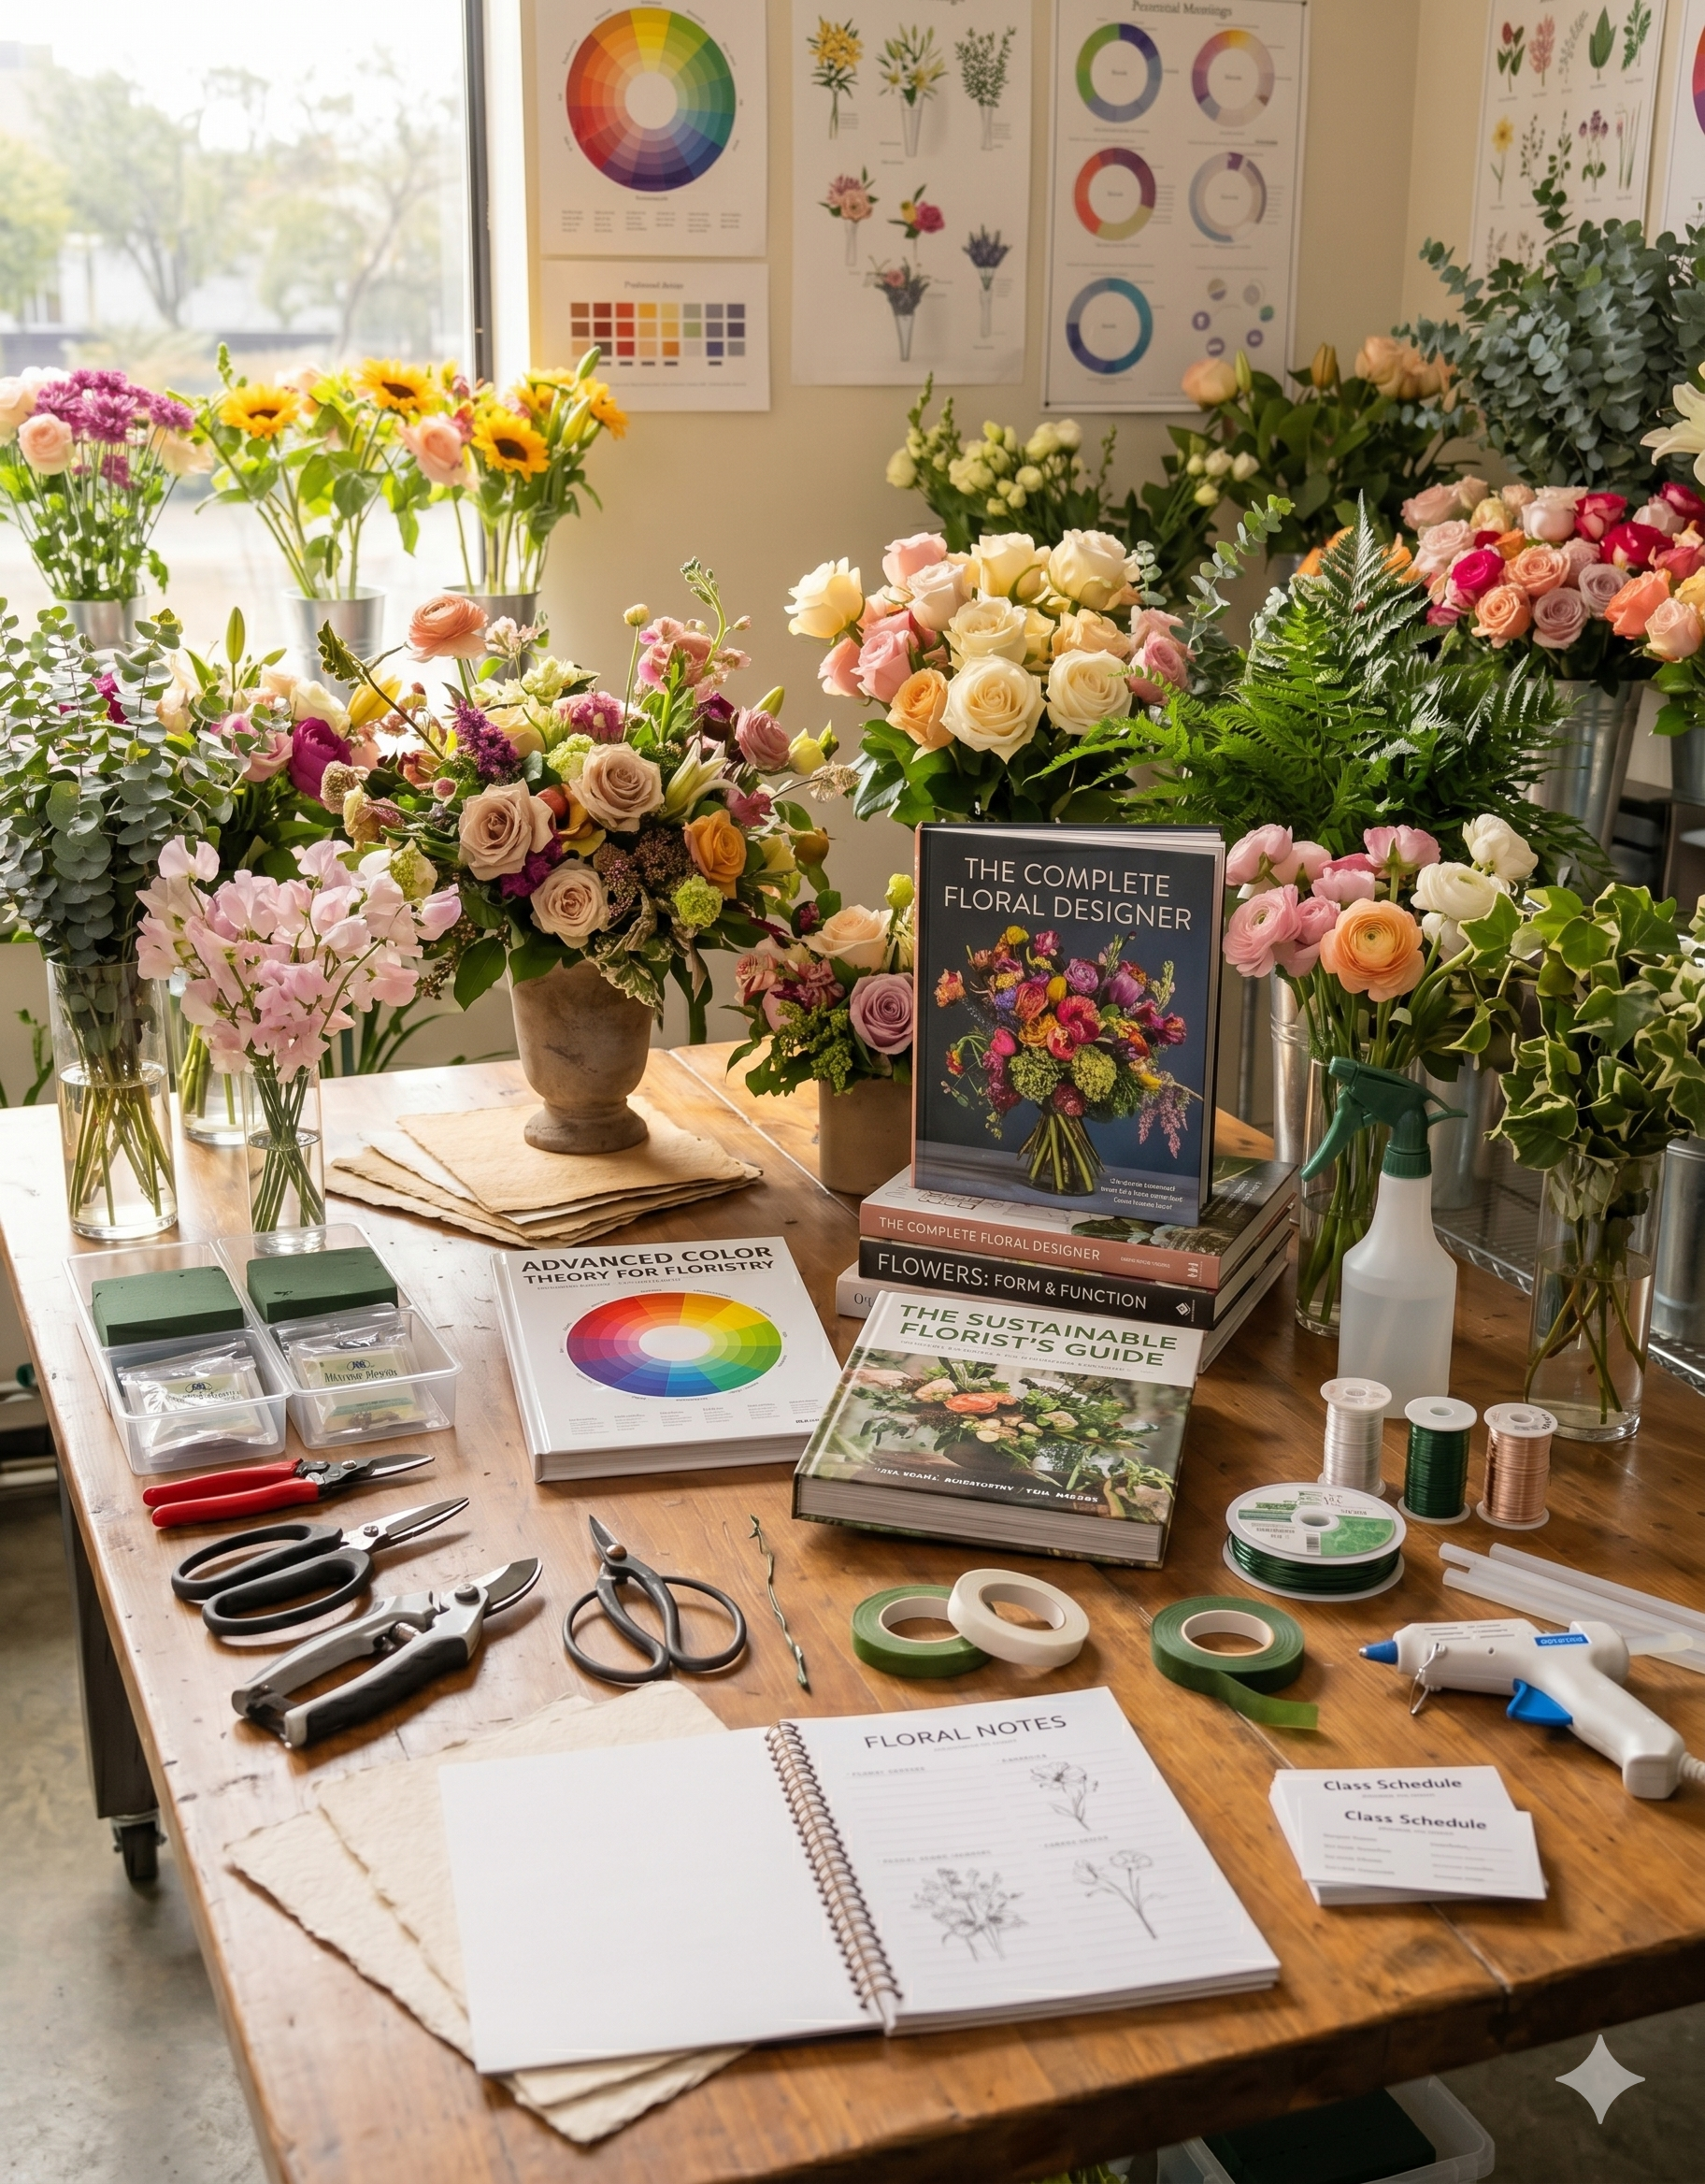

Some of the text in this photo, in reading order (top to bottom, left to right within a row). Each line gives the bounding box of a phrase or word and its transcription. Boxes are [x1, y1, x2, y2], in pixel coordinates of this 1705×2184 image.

[964, 857, 1170, 898] THE COMPLETE
[944, 886, 1192, 930] FLORAL DESIGNER
[522, 1246, 774, 1272] ADVANCED COLOR
[879, 1216, 1101, 1261] THE COMPLETE FLORAL DESIGNER
[523, 1270, 610, 1284] THEORY
[617, 1266, 659, 1279] FOR
[665, 1259, 775, 1275] FLORISTRY
[878, 1253, 1147, 1310] FLOWERS: FORM & FUNCTION
[898, 1322, 1054, 1354] FLORIST'S
[1064, 1343, 1165, 1367] GUIDE
[899, 1304, 1178, 1350] THE SUSTAINABLE
[864, 1728, 971, 1749] FLORAL
[976, 1715, 1067, 1738] NOTES
[1324, 1778, 1463, 1790] Class Schedule
[1344, 1810, 1487, 1830] Class Schedule
